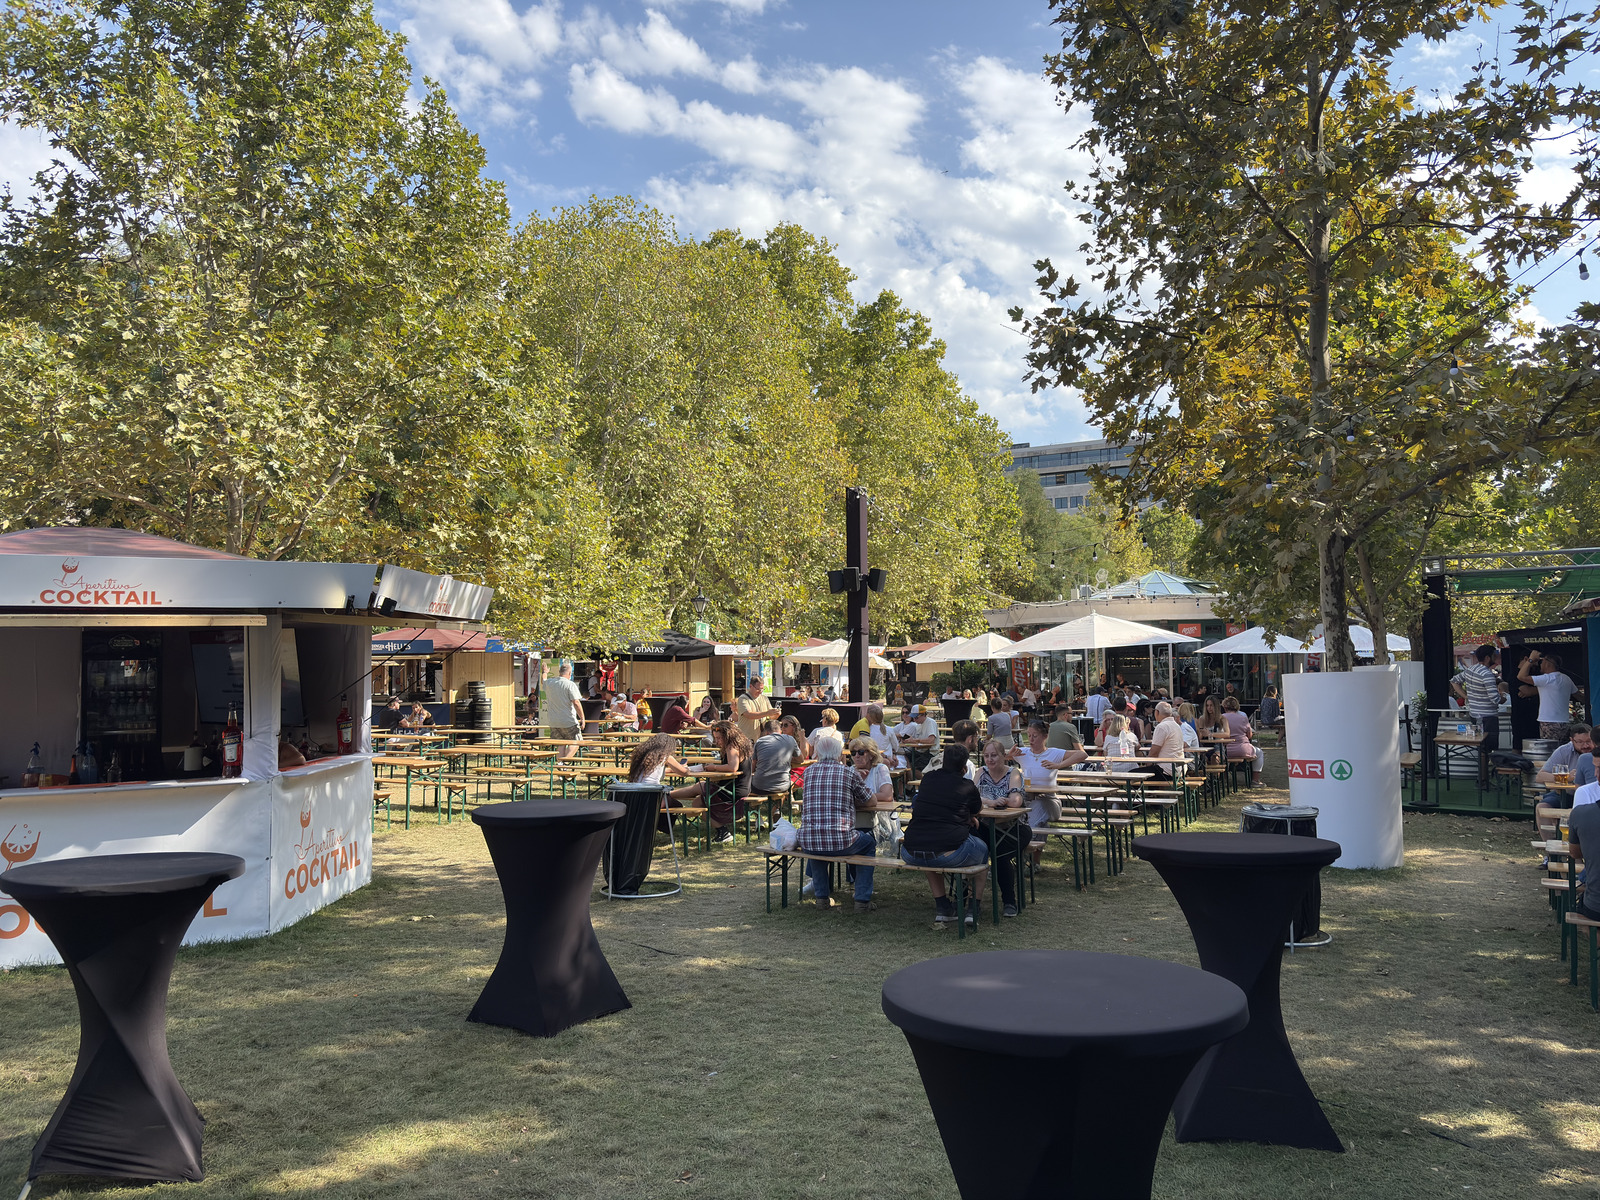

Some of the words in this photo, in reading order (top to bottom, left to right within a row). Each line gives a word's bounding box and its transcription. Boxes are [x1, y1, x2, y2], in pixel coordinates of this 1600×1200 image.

[39, 589, 162, 605] COCKTAIL
[70, 575, 142, 598] Aperitivo
[1524, 636, 1550, 644] BELGA
[1552, 634, 1580, 643] SÖRÖK
[304, 828, 349, 859] Aperitivo
[285, 841, 361, 899] COCKTAIL
